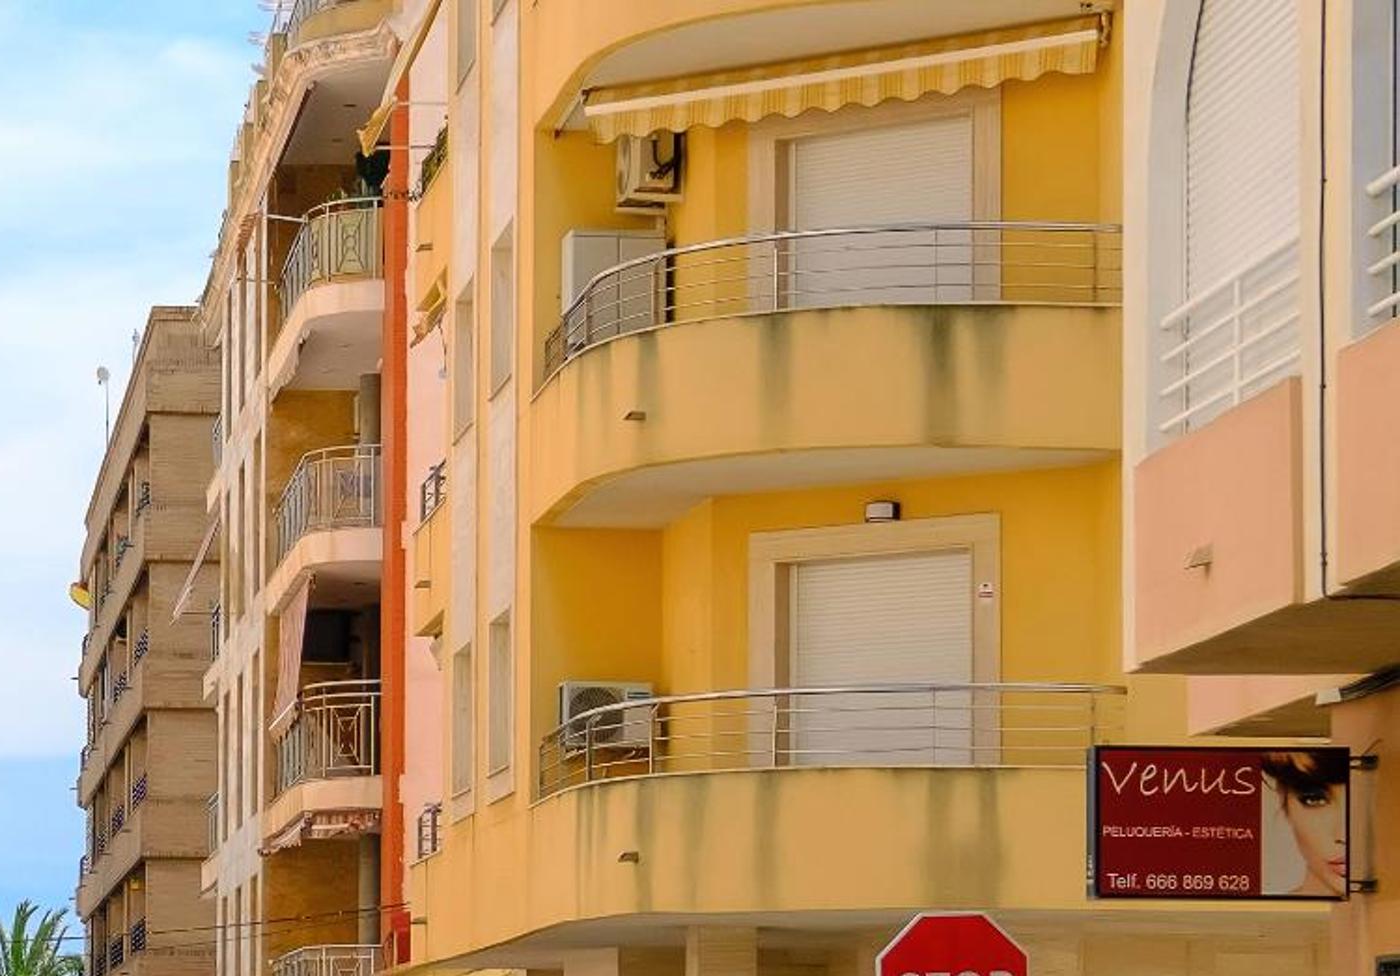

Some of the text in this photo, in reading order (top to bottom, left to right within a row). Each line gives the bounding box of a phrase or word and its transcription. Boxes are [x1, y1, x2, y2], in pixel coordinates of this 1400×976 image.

[1101, 760, 1256, 795] Venus
[1102, 825, 1183, 838] PELUQUERÍA
[1106, 873, 1141, 889] Telf.
[1218, 875, 1250, 891] 628
